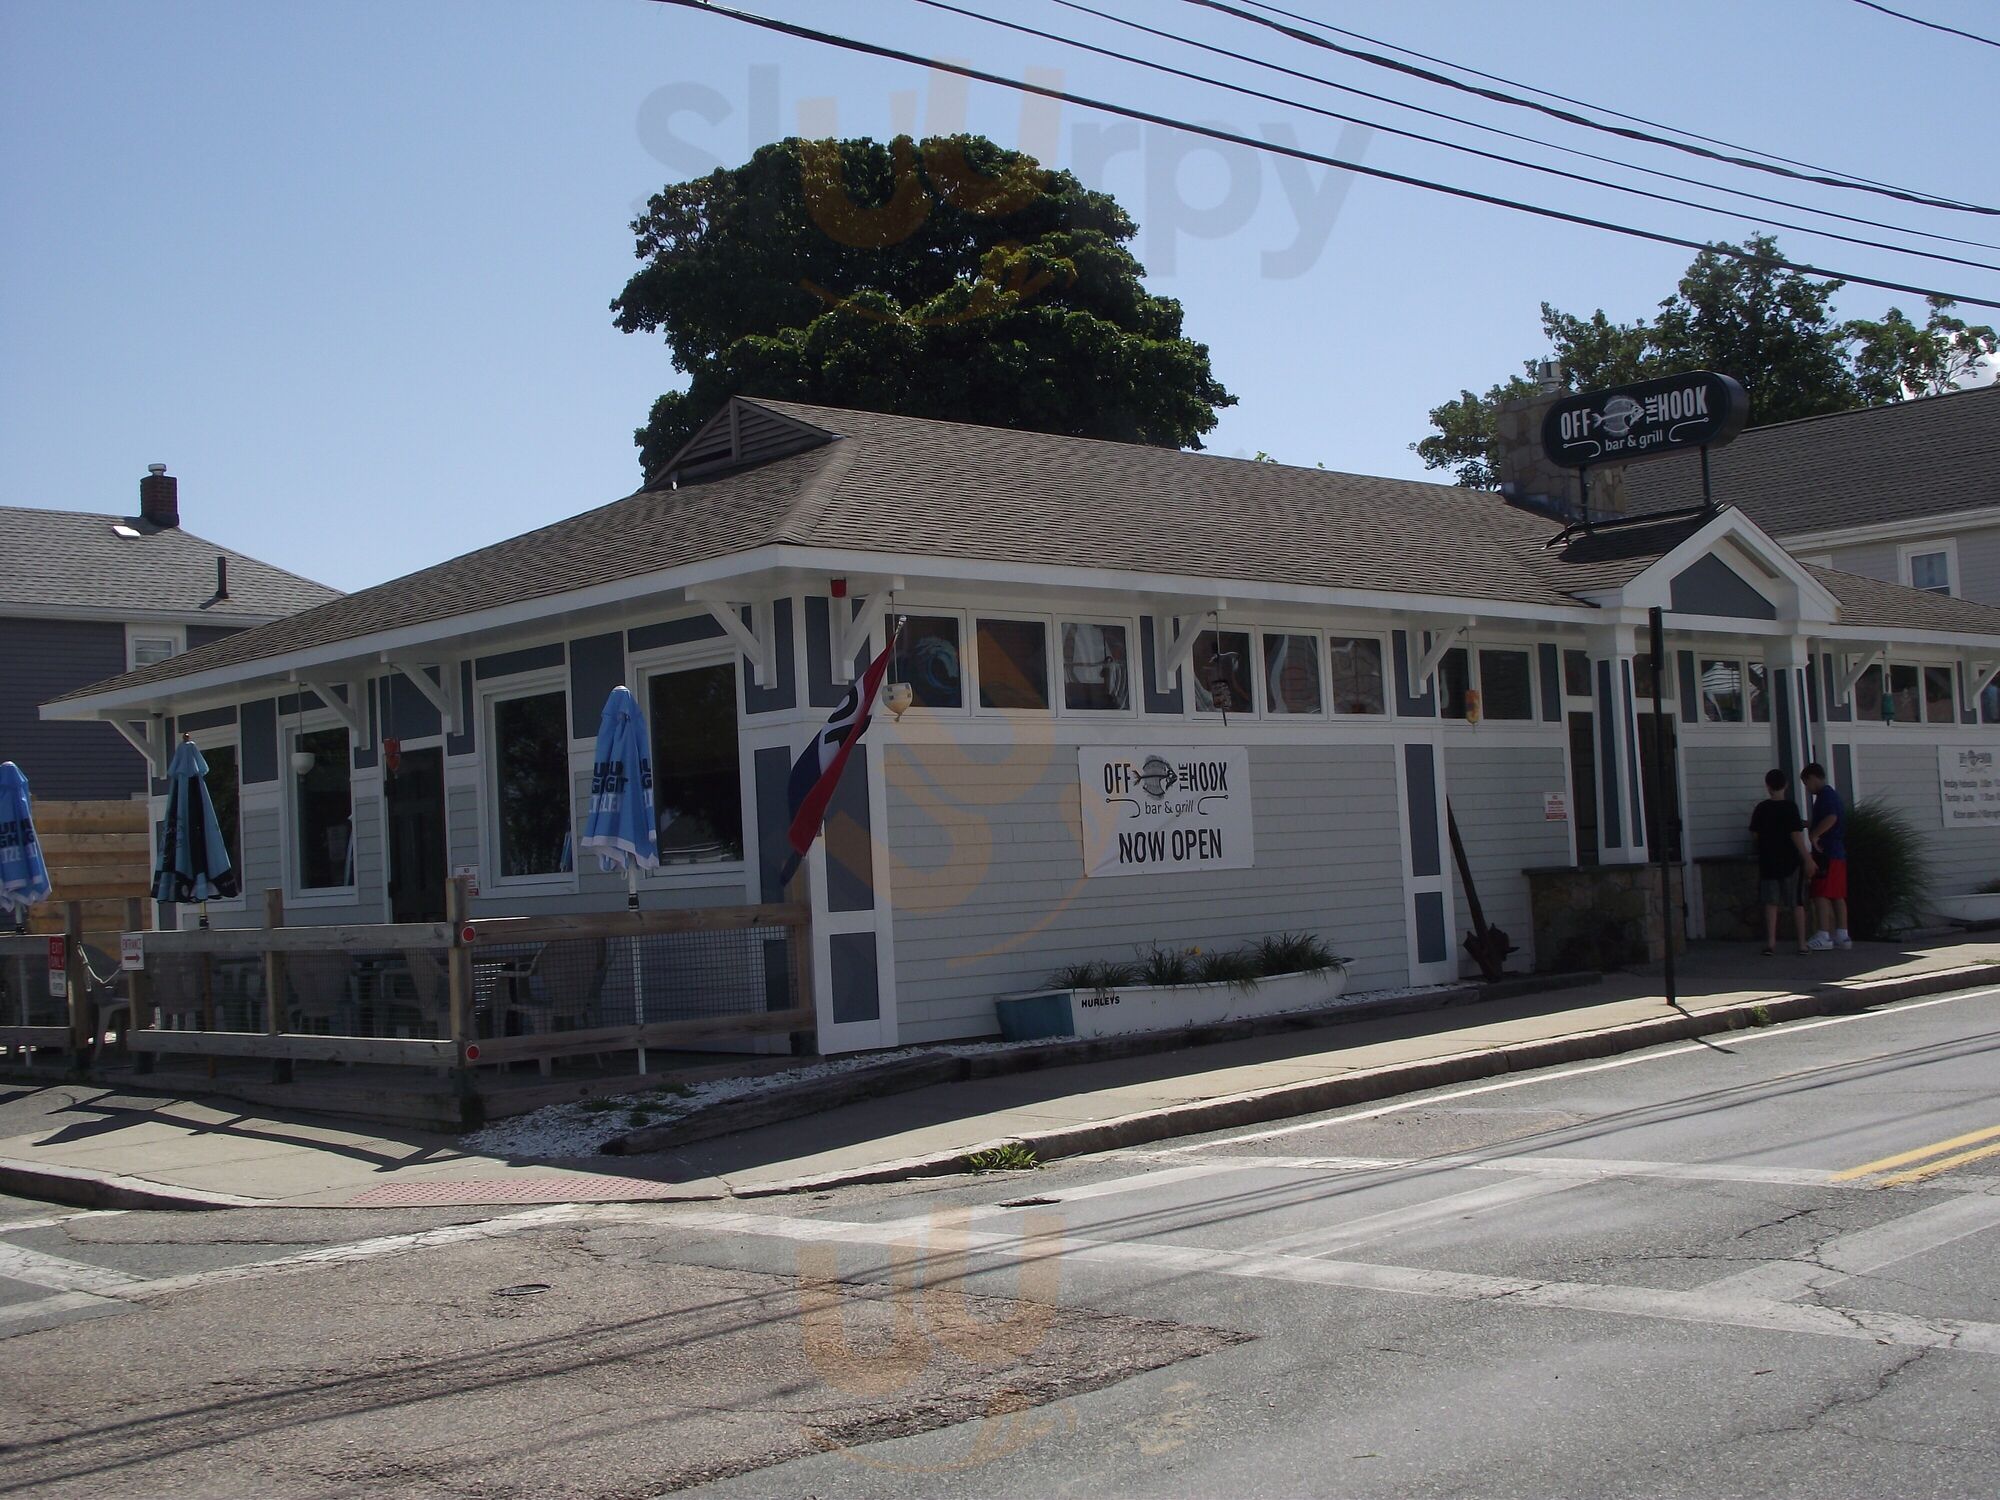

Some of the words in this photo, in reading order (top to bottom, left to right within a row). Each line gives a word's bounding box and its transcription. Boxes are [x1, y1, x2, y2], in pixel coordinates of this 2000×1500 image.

[1560, 408, 1592, 440] OFF
[1644, 394, 1659, 424] THE
[1658, 385, 1709, 422] HOOK
[1605, 438, 1625, 452] bar
[1627, 434, 1637, 448] &
[1639, 429, 1664, 449] grill
[1103, 763, 1132, 794] OFF
[1178, 763, 1190, 792] THE
[1190, 761, 1228, 792] HOOK
[1145, 801, 1162, 815] bar
[1164, 800, 1174, 814] &
[1175, 800, 1194, 817] grill
[1118, 831, 1165, 864] NOW
[1171, 828, 1223, 861] OPEN
